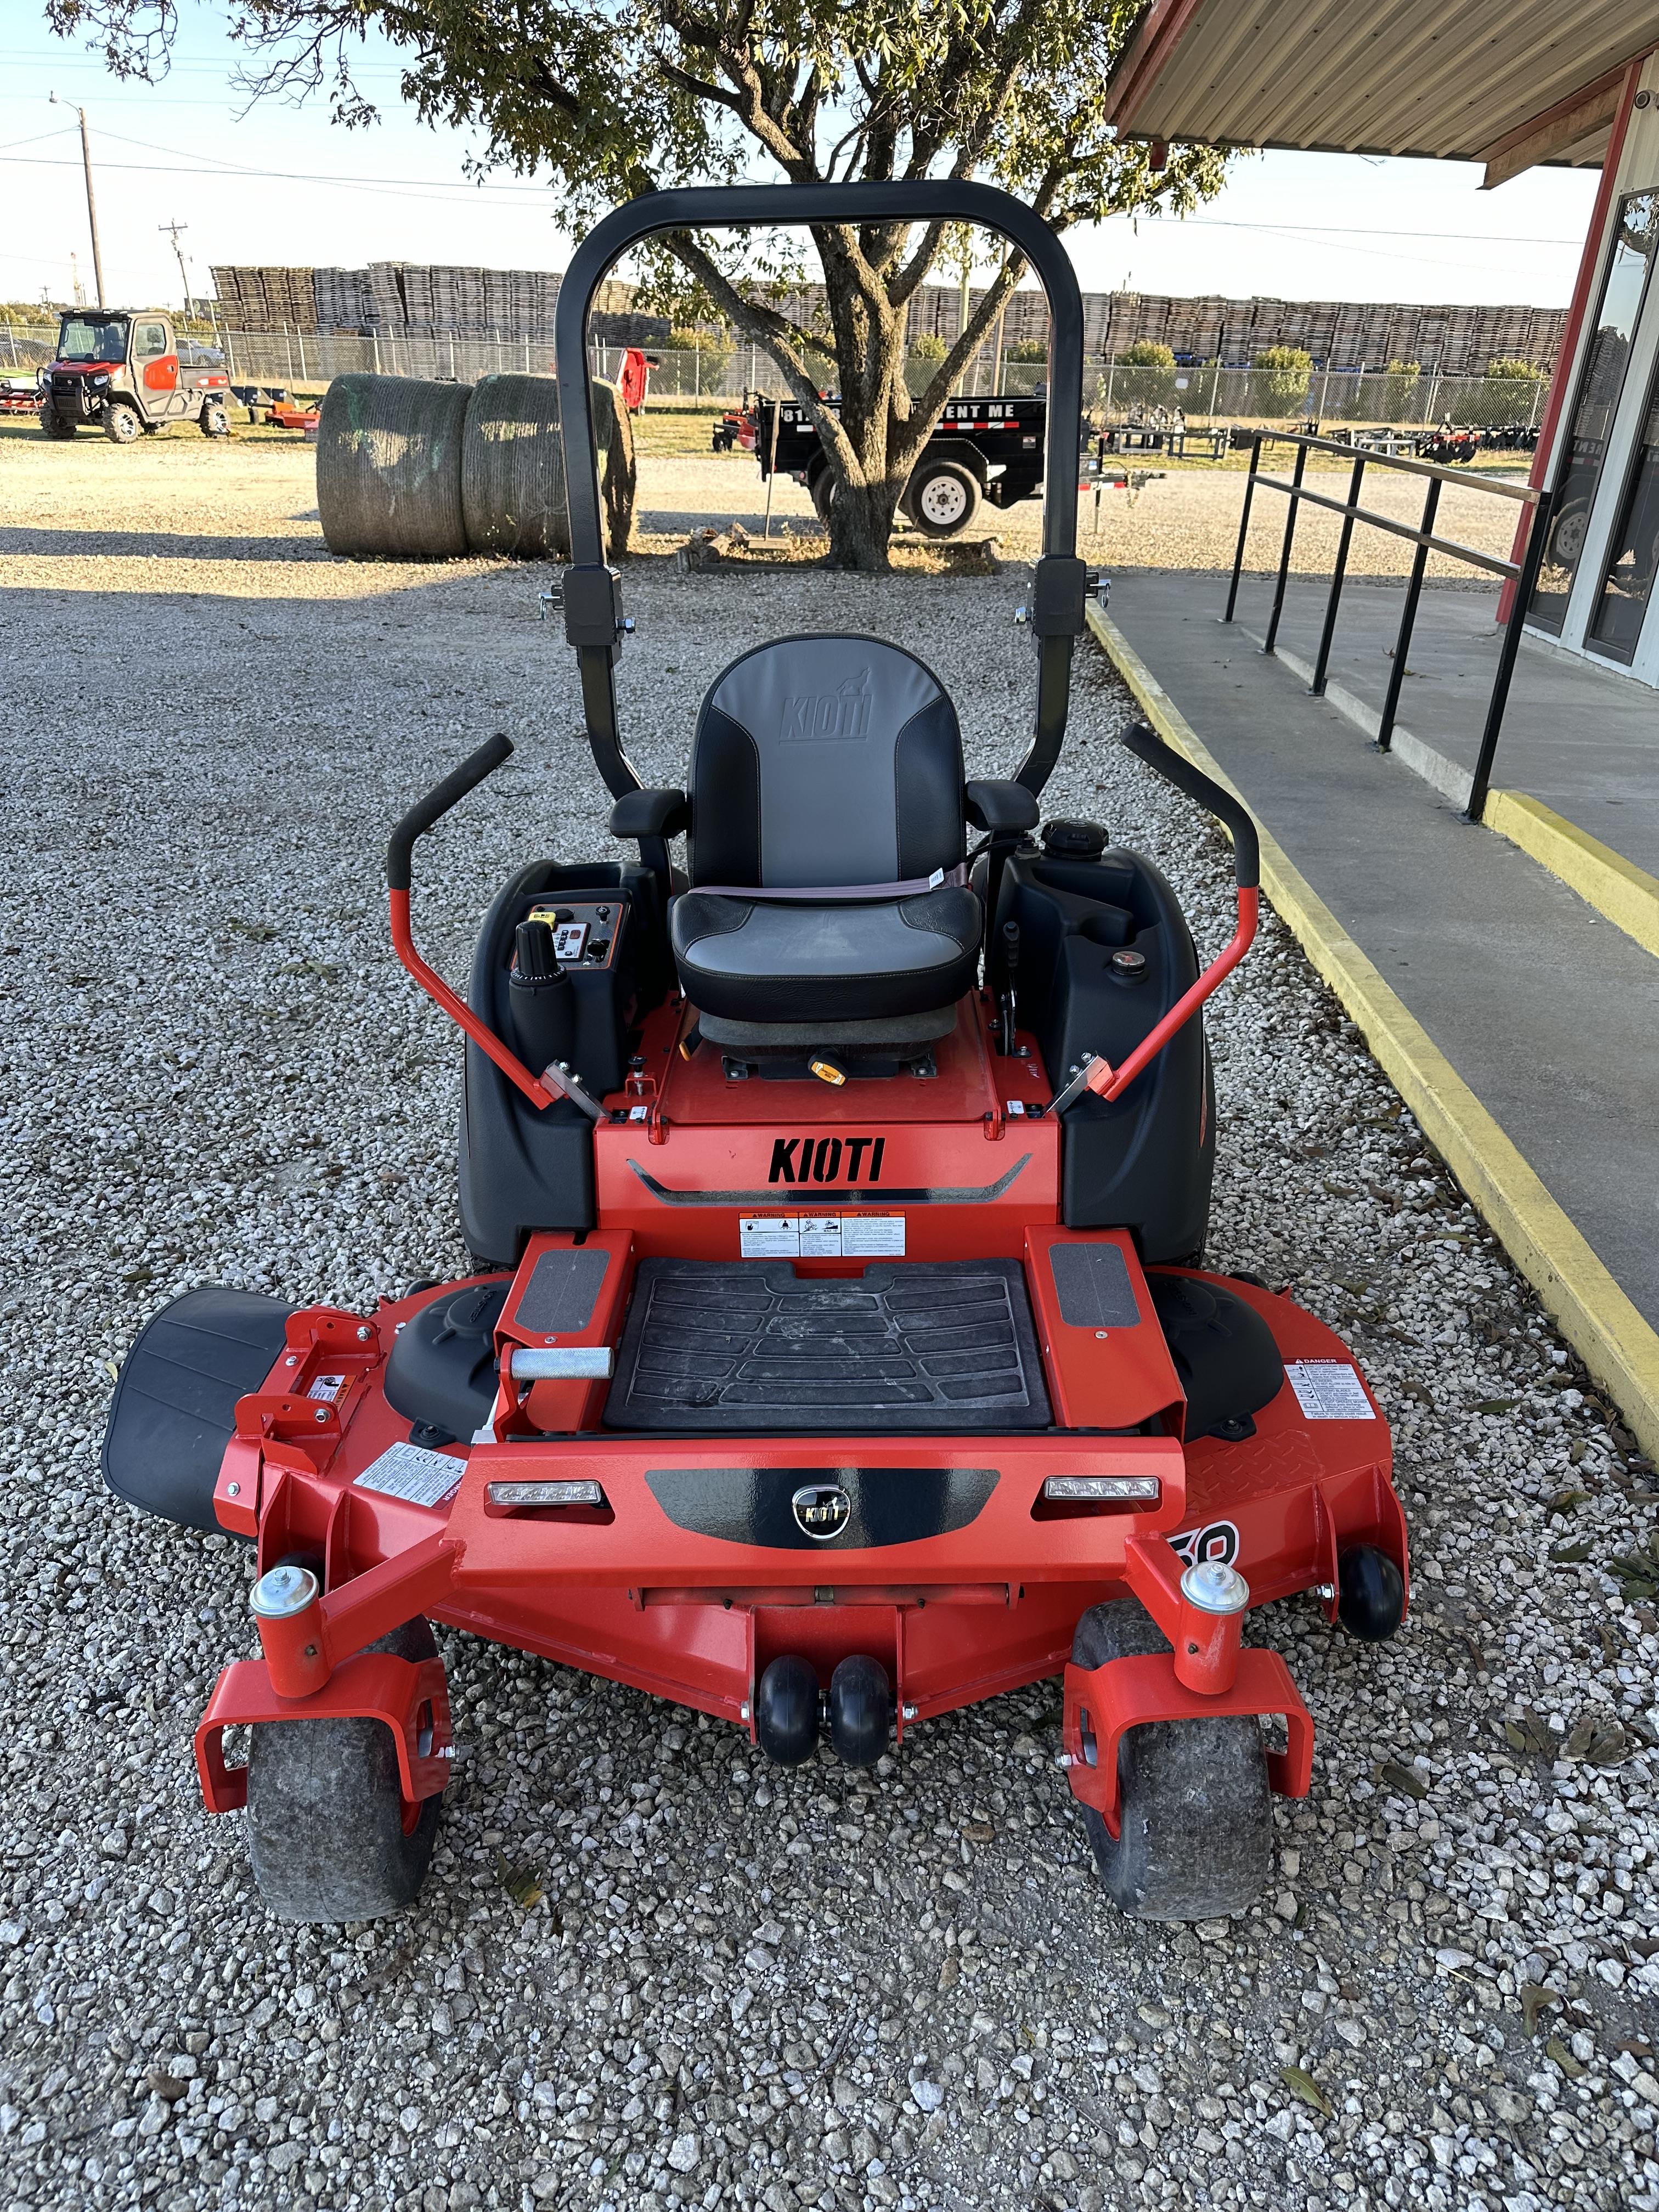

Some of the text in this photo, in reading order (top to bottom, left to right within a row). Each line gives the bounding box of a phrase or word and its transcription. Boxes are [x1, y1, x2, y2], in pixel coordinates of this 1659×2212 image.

[940, 404, 1014, 419] ENT ME
[779, 694, 873, 738] KIOTI
[768, 1137, 885, 1183] KIOTI
[442, 1480, 462, 1502] ANGER
[805, 1505, 839, 1522] KIOTI
